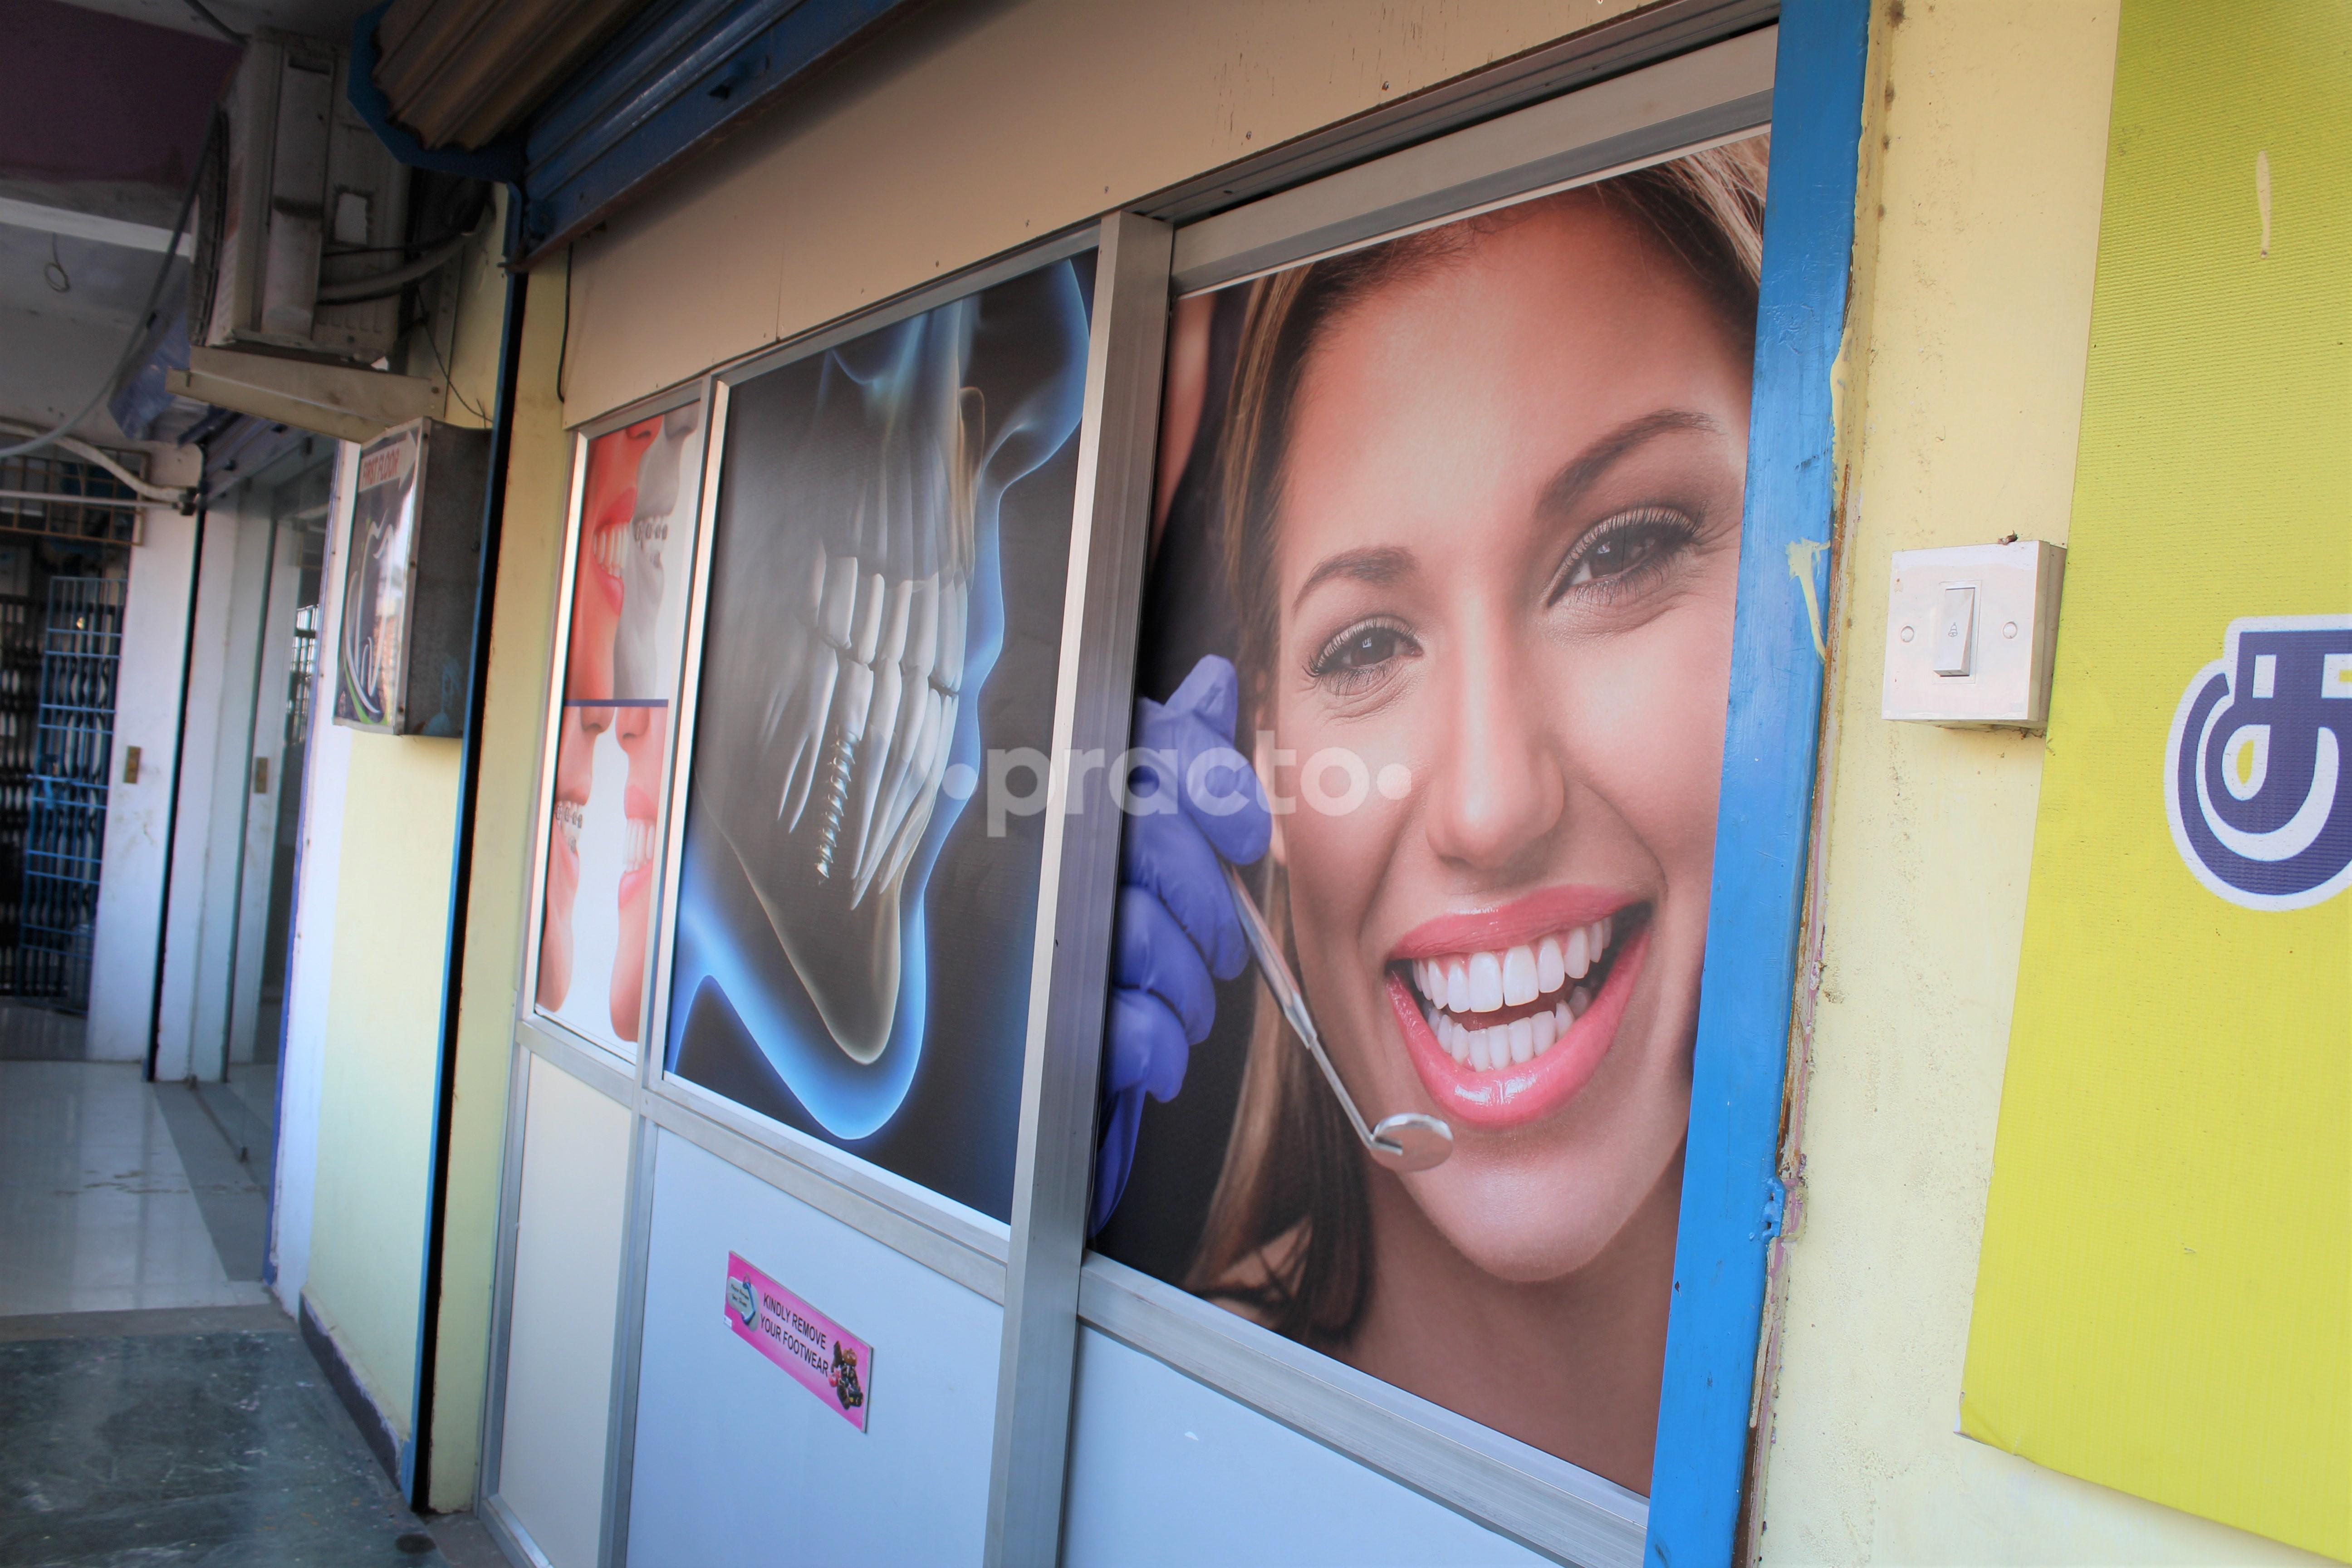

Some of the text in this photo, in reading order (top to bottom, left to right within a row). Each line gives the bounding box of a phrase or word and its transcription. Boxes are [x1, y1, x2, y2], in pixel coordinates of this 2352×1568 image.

[760, 1313, 828, 1377] YOUR FOOTWEAR
[764, 1292, 826, 1350] KINDLY REMOVE
